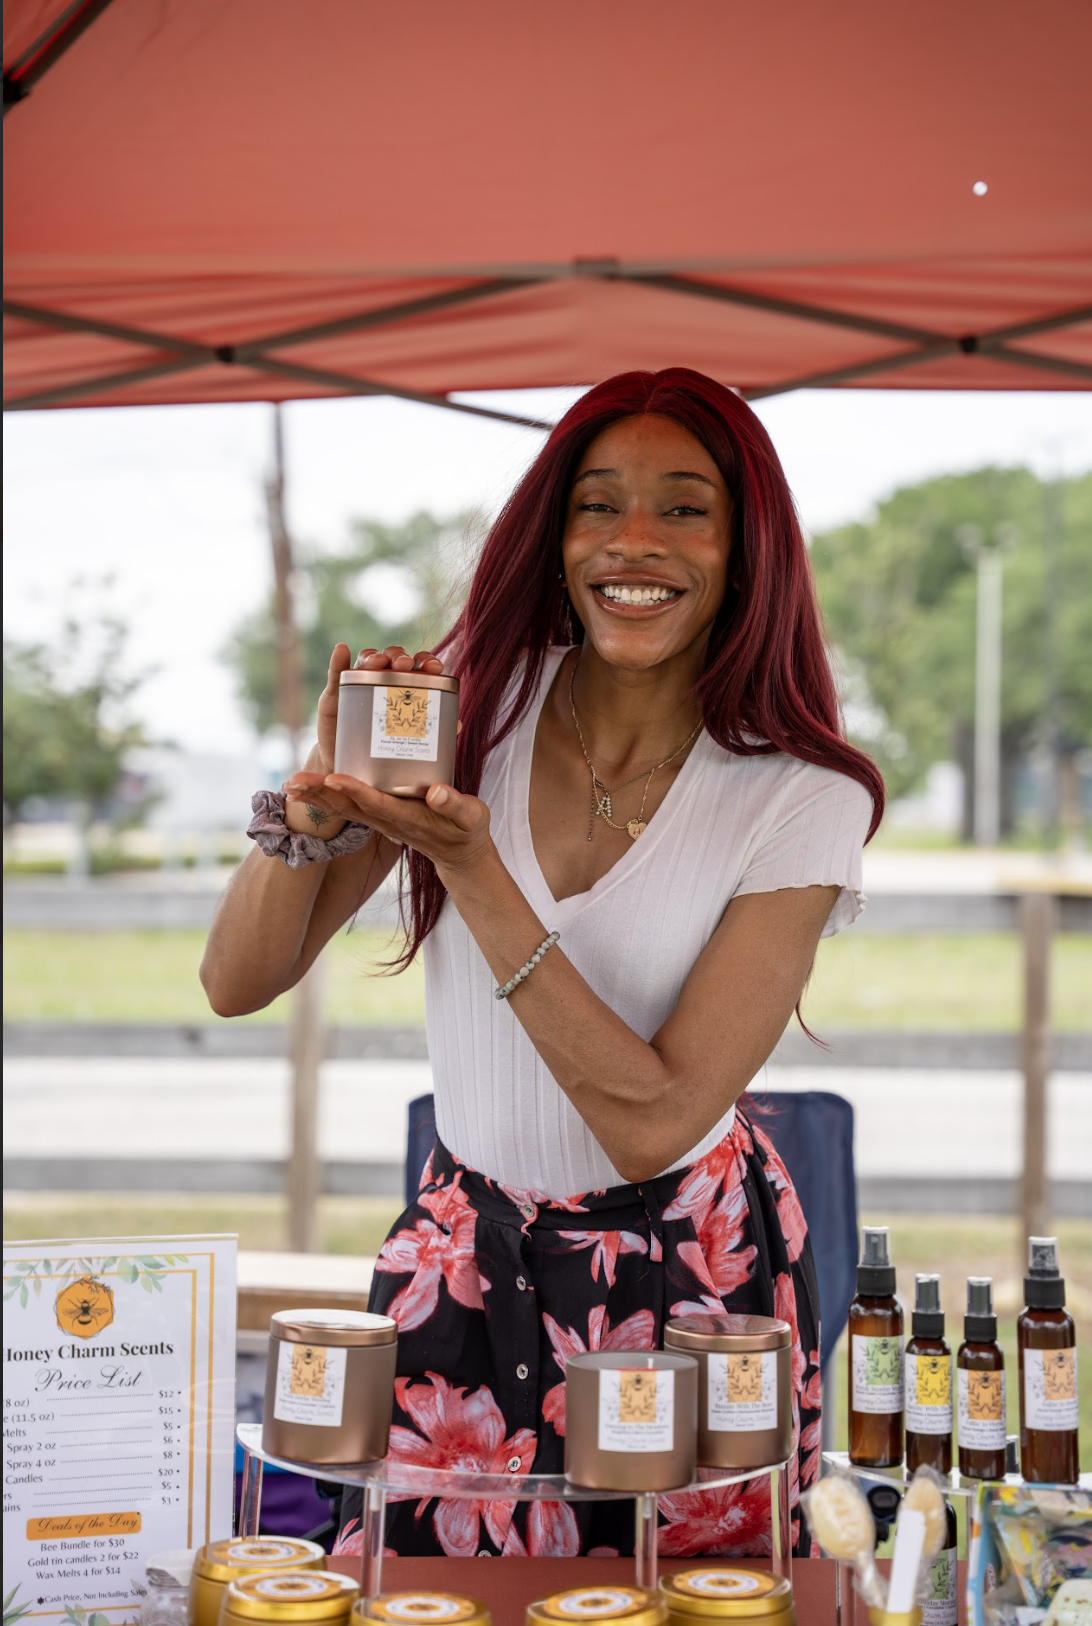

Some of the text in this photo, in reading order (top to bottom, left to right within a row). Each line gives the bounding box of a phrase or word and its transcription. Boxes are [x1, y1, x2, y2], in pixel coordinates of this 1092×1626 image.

[57, 1344, 116, 1360] Charm
[120, 1342, 174, 1357] Scents
[34, 1365, 144, 1392] Price List
[13, 1398, 30, 1408] oz)
[158, 1389, 174, 1399] $12
[11, 1413, 37, 1424] (11.5
[38, 1411, 55, 1422] oz)
[158, 1405, 174, 1415] $15
[163, 1421, 174, 1431] $5
[6, 1435, 174, 1455] Spray 2 oz $6
[6, 1450, 174, 1472] Spray 4 oz $8
[4, 1467, 174, 1485] Candles $20
[161, 1480, 172, 1491] $5
[161, 1496, 172, 1506] $3
[37, 1514, 138, 1534] Deals of the Day
[40, 1538, 125, 1552] Bee Bundle for $30
[27, 1550, 139, 1568] Gold tin candles 2 for $22
[35, 1565, 121, 1580] Wax Melts 4 for $14
[43, 1595, 62, 1603] Cash
[62, 1594, 82, 1605] Price,
[83, 1592, 97, 1600] Not
[98, 1590, 129, 1600] Including
